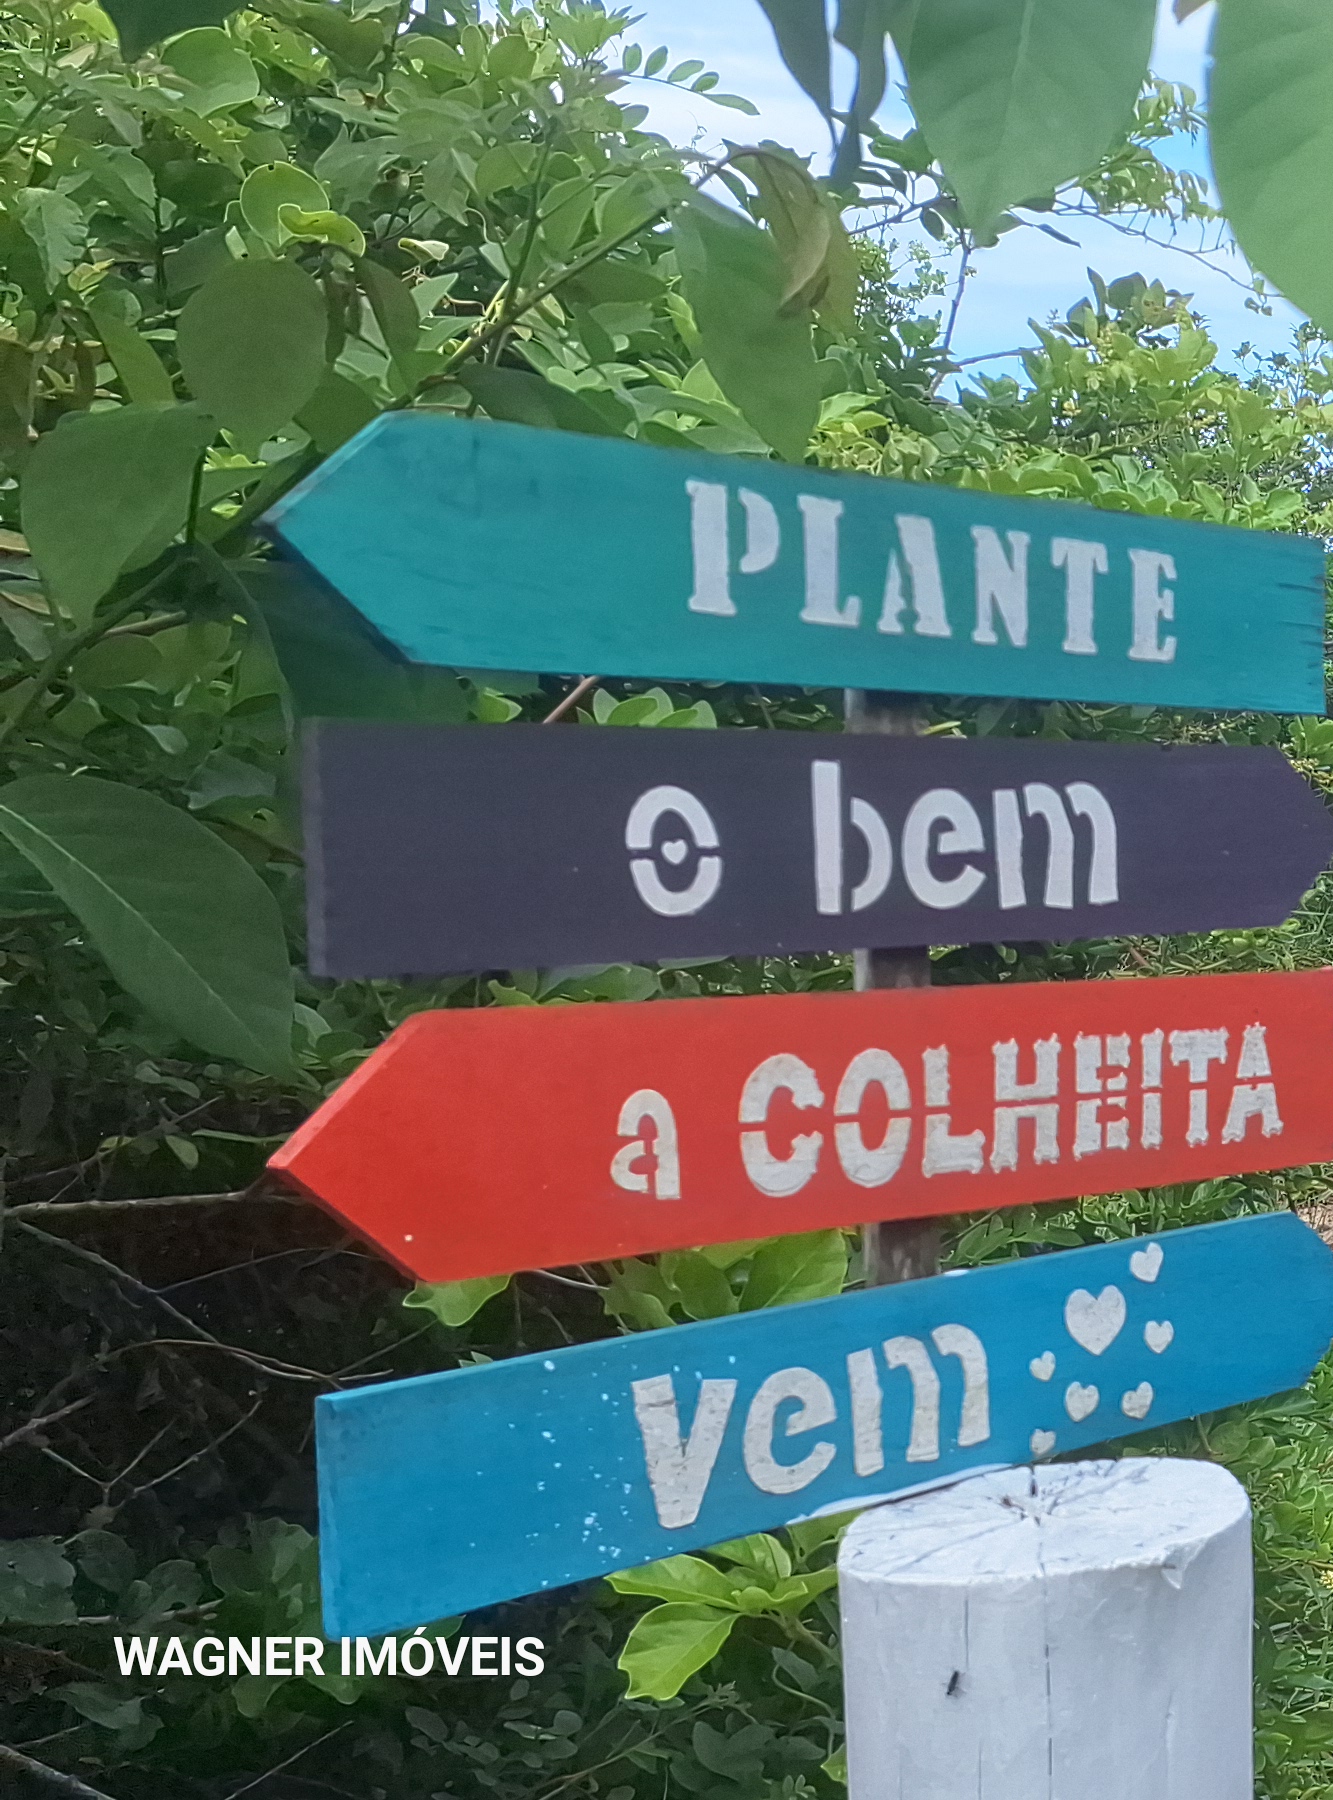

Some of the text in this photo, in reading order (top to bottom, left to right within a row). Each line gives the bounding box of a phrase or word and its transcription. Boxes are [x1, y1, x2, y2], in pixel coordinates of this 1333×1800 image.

[684, 479, 1178, 663] PLANTE
[626, 760, 1119, 916] o bem
[610, 1021, 1284, 1199] a COLHEITA
[632, 1323, 992, 1529] vem
